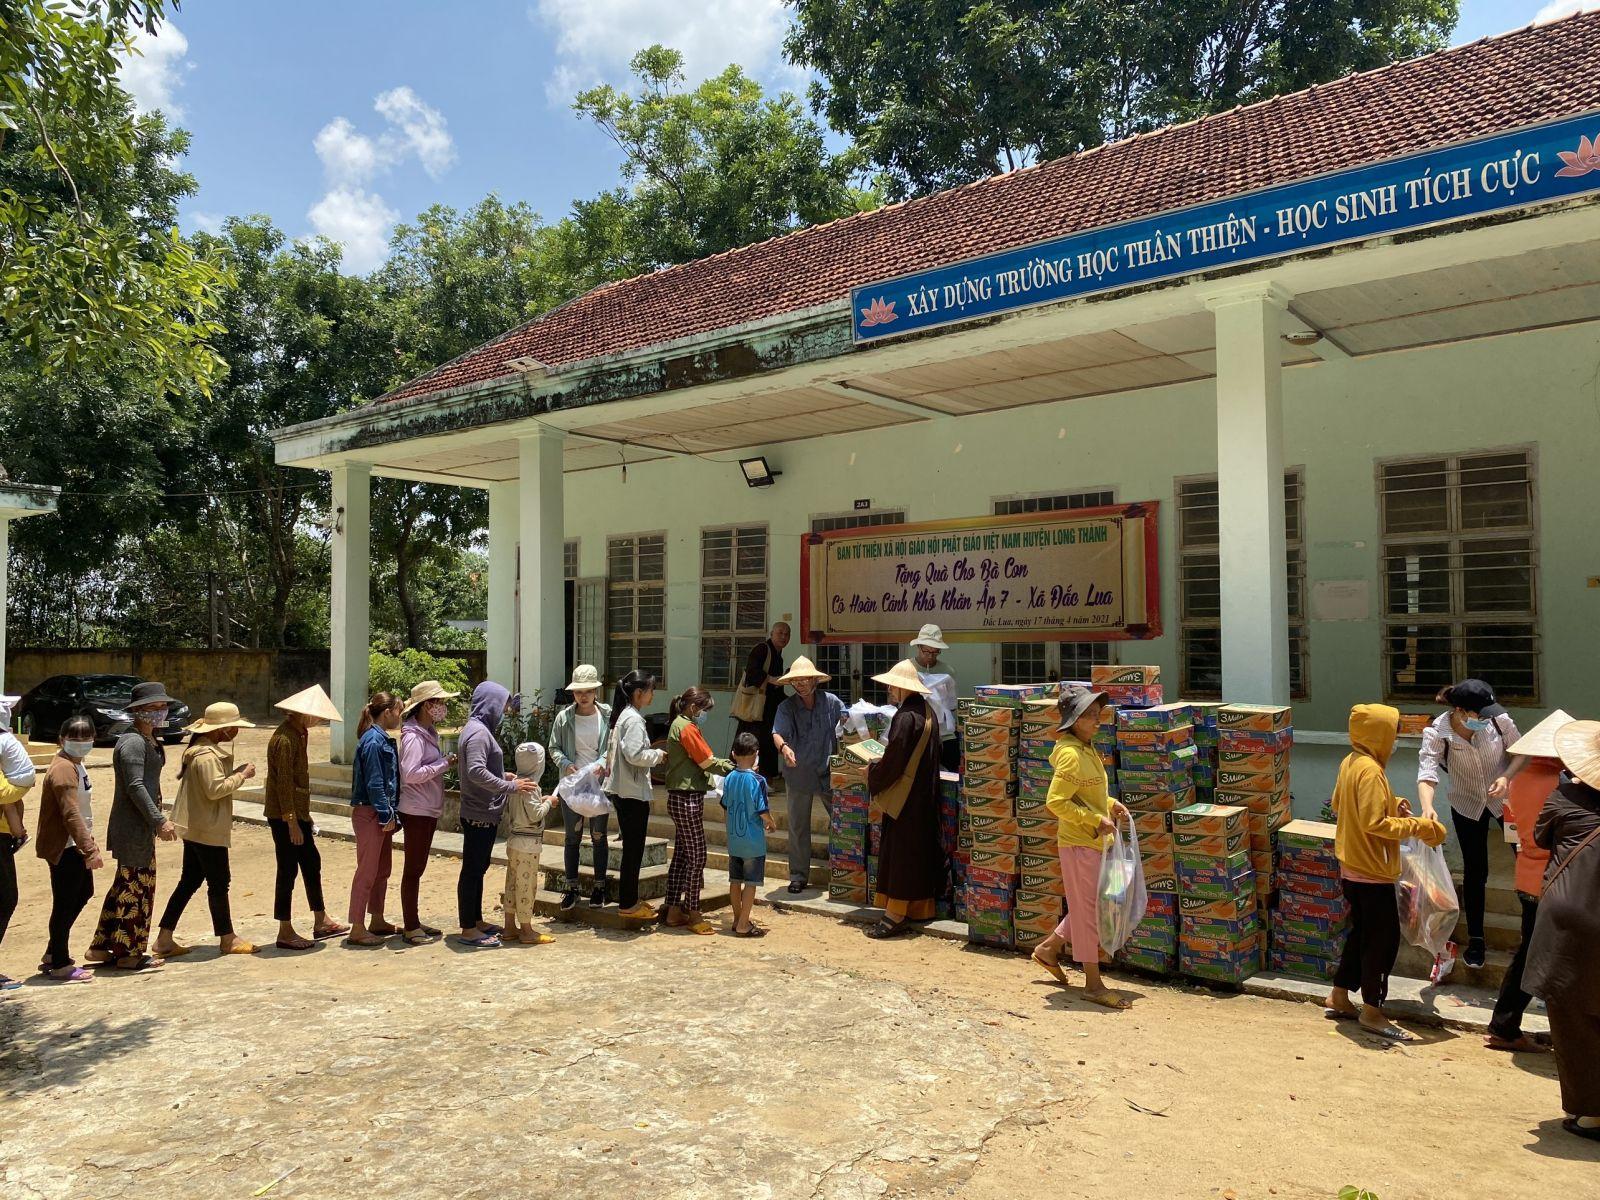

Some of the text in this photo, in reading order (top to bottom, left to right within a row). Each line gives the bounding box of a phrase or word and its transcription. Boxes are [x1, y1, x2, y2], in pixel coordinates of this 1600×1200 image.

[907, 285, 938, 317] XÂY
[944, 276, 992, 311] DỰNG
[996, 258, 1073, 297] TRƯỜNG
[1077, 246, 1119, 281] HỌC
[1124, 229, 1182, 269] THÂN
[1187, 212, 1257, 254] THIỆN
[1276, 200, 1328, 239] HỌC
[1335, 184, 1398, 224] SINH
[1404, 167, 1472, 209] TÍCH
[1481, 149, 1541, 196] CỰC
[837, 523, 1107, 561] BAN TỪ THIỆN XÃ HỘI GIÁO HỘI PHẬT GIÁO VIỆT NAM HUYỆN LONG THÀNH
[895, 557, 1028, 588] Tặng Quà Cho Bà Con
[832, 594, 845, 614] Có
[849, 593, 877, 613] Hoàn
[881, 589, 908, 612] Cảnh
[912, 588, 936, 611] Khó
[941, 587, 971, 611] Khăn
[976, 580, 996, 615] Ấp
[1000, 590, 1009, 609] 7
[1027, 586, 1045, 609] Xã
[1050, 584, 1079, 609] Đắc
[1084, 583, 1113, 606] Lua
[1015, 616, 1031, 628] ngày
[1034, 616, 1042, 625] 17
[1043, 616, 1064, 627] tháng
[1073, 615, 1089, 625] năm
[1091, 614, 1110, 624] 2021
[728, 800, 748, 837] 10
